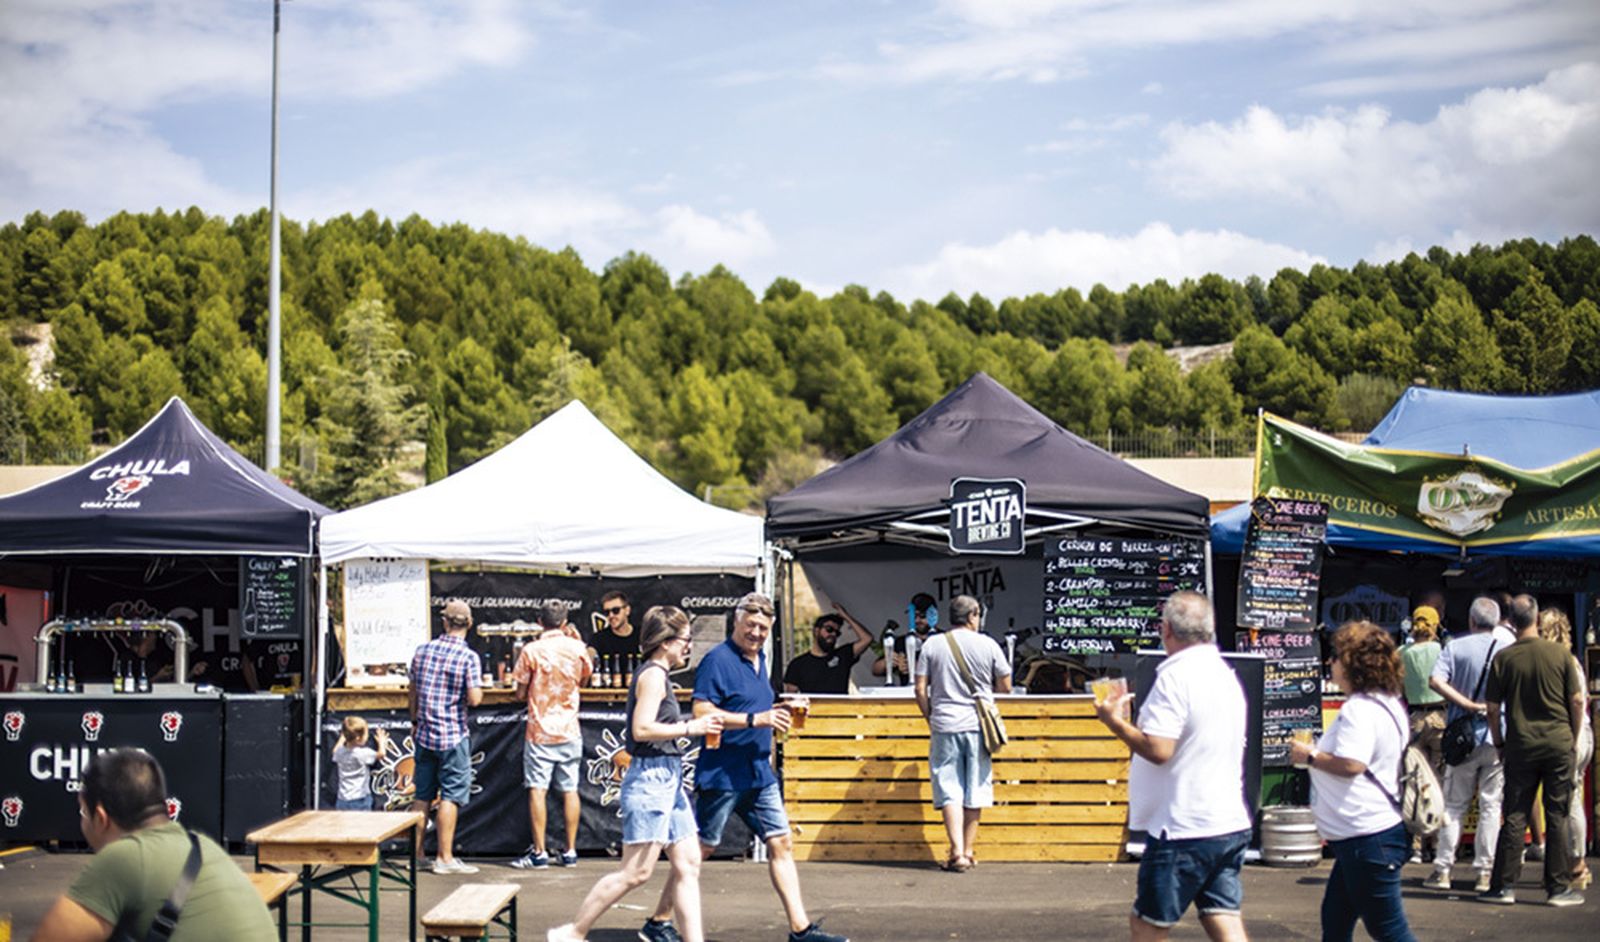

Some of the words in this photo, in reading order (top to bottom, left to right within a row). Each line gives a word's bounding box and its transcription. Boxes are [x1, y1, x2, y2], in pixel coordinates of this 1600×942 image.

[90, 459, 190, 480] CHULA
[952, 494, 1021, 528] TENTA
[1525, 505, 1600, 525] ARTESA
[933, 567, 1006, 601] TENTA
[1058, 617, 1088, 628] REBEL
[268, 642, 298, 654] CHULA
[1285, 634, 1313, 647] BEER
